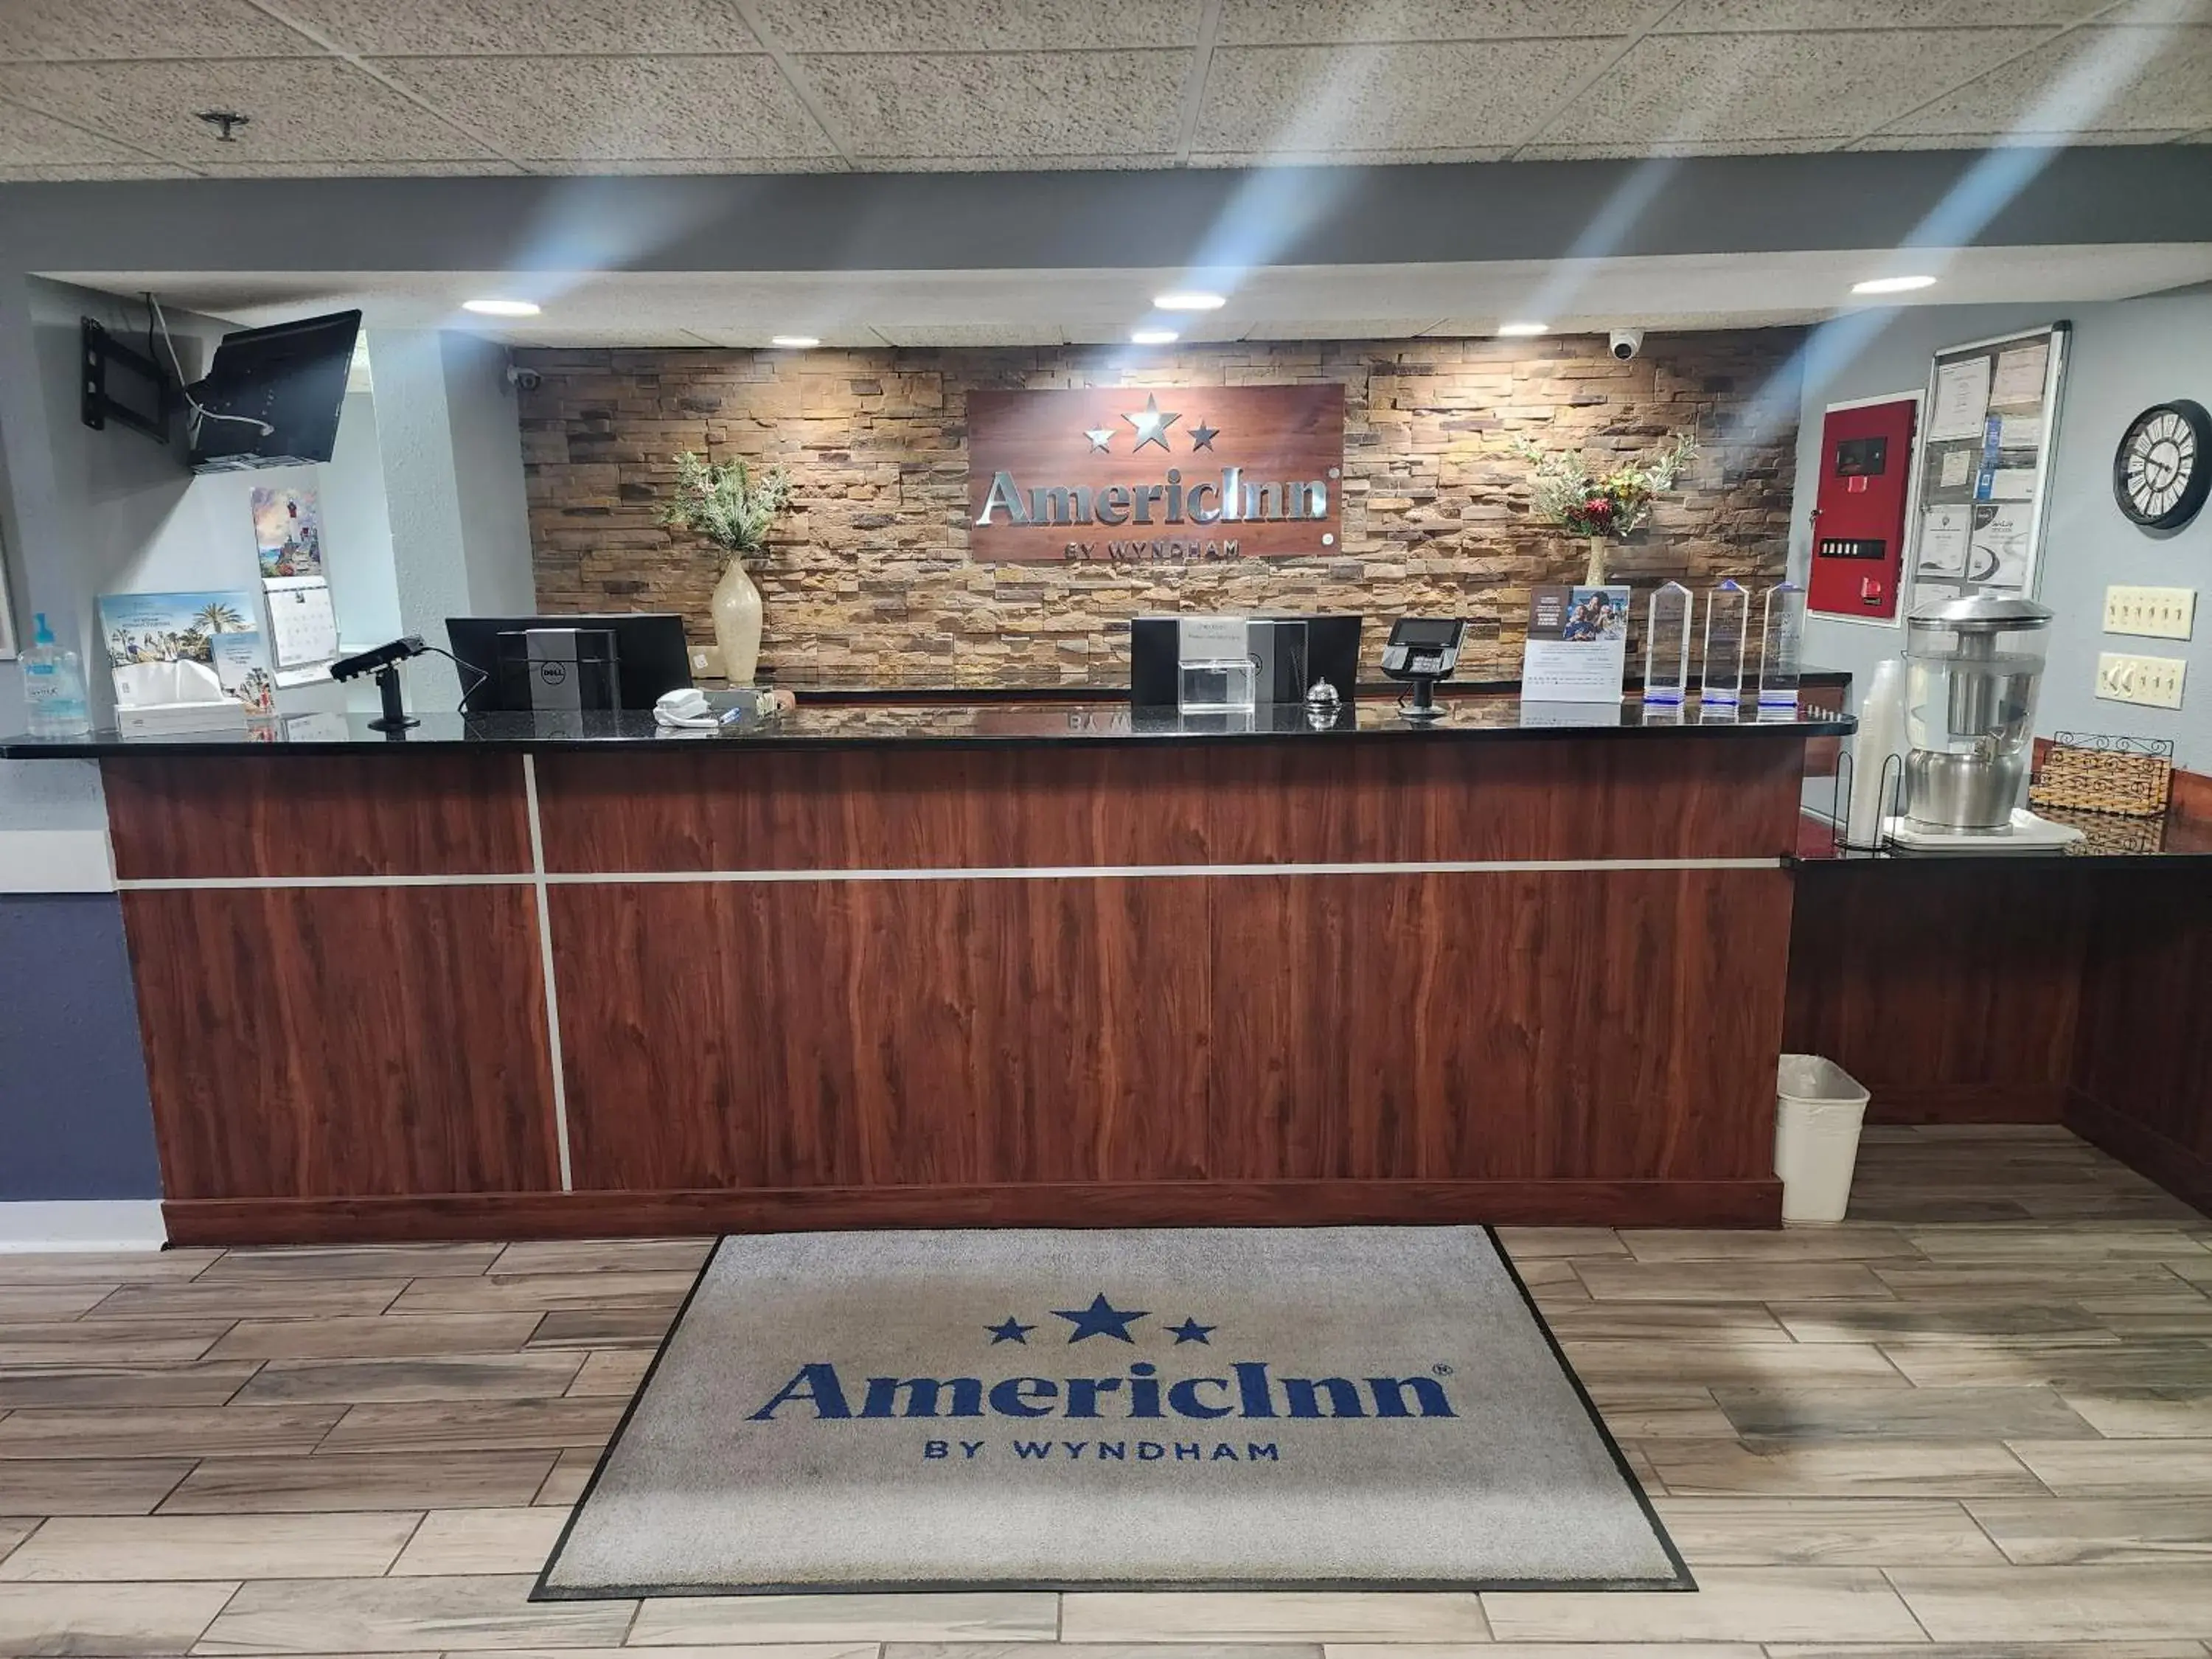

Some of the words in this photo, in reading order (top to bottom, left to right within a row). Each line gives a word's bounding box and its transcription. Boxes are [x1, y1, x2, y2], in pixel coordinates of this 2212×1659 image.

[975, 467, 1328, 526] AmericInn
[1064, 542, 1096, 560] BY
[1108, 539, 1240, 560] WYNDHAM
[744, 1362, 1460, 1420] AmericInn
[924, 1441, 984, 1459] BY
[1013, 1440, 1279, 1461] WYNDHAM
